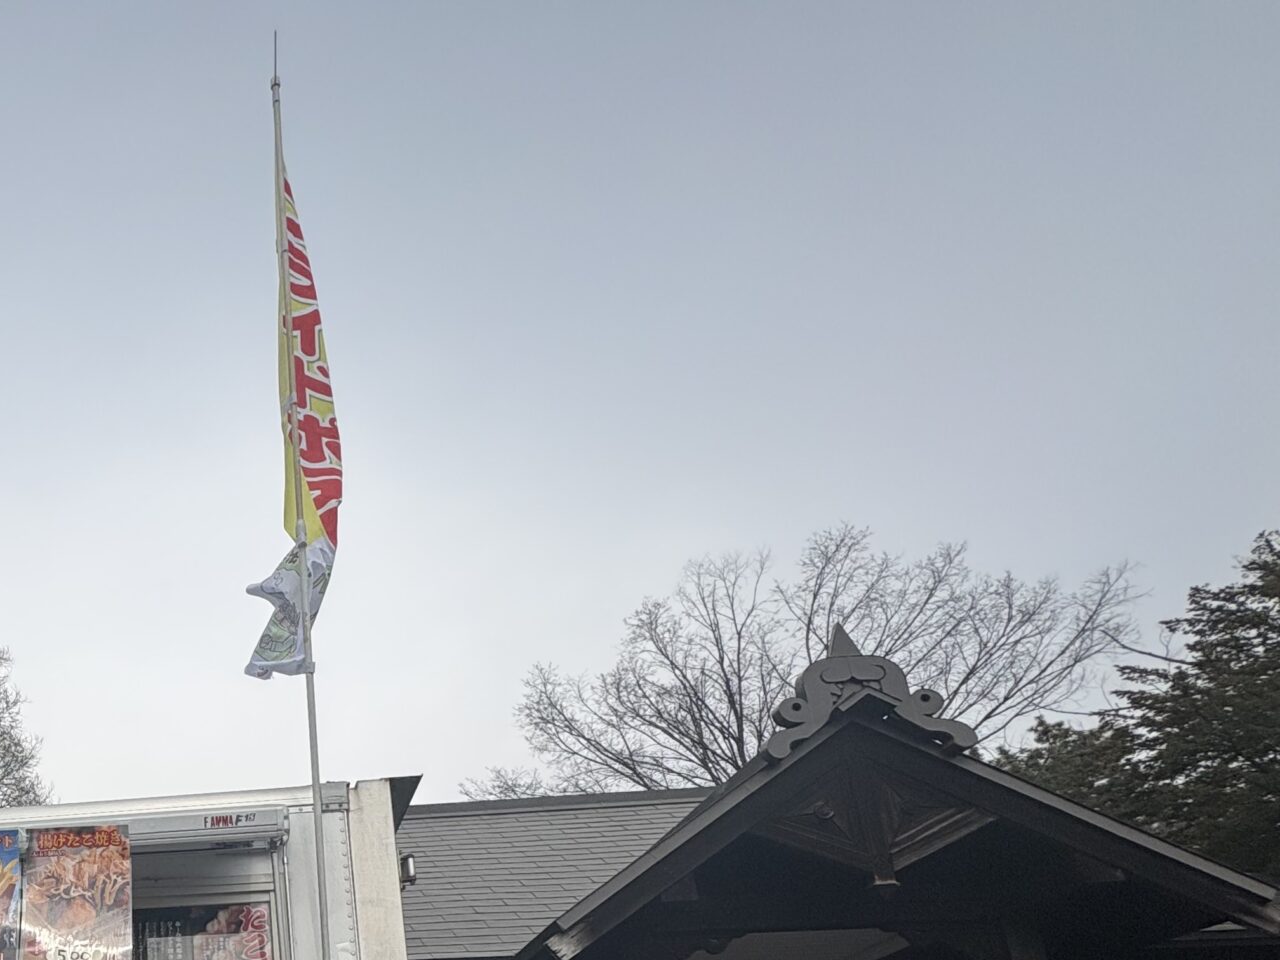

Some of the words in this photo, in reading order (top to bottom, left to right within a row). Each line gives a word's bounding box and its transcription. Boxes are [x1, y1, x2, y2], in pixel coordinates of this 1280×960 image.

[38, 831, 123, 850] 揚げたこ焼き
